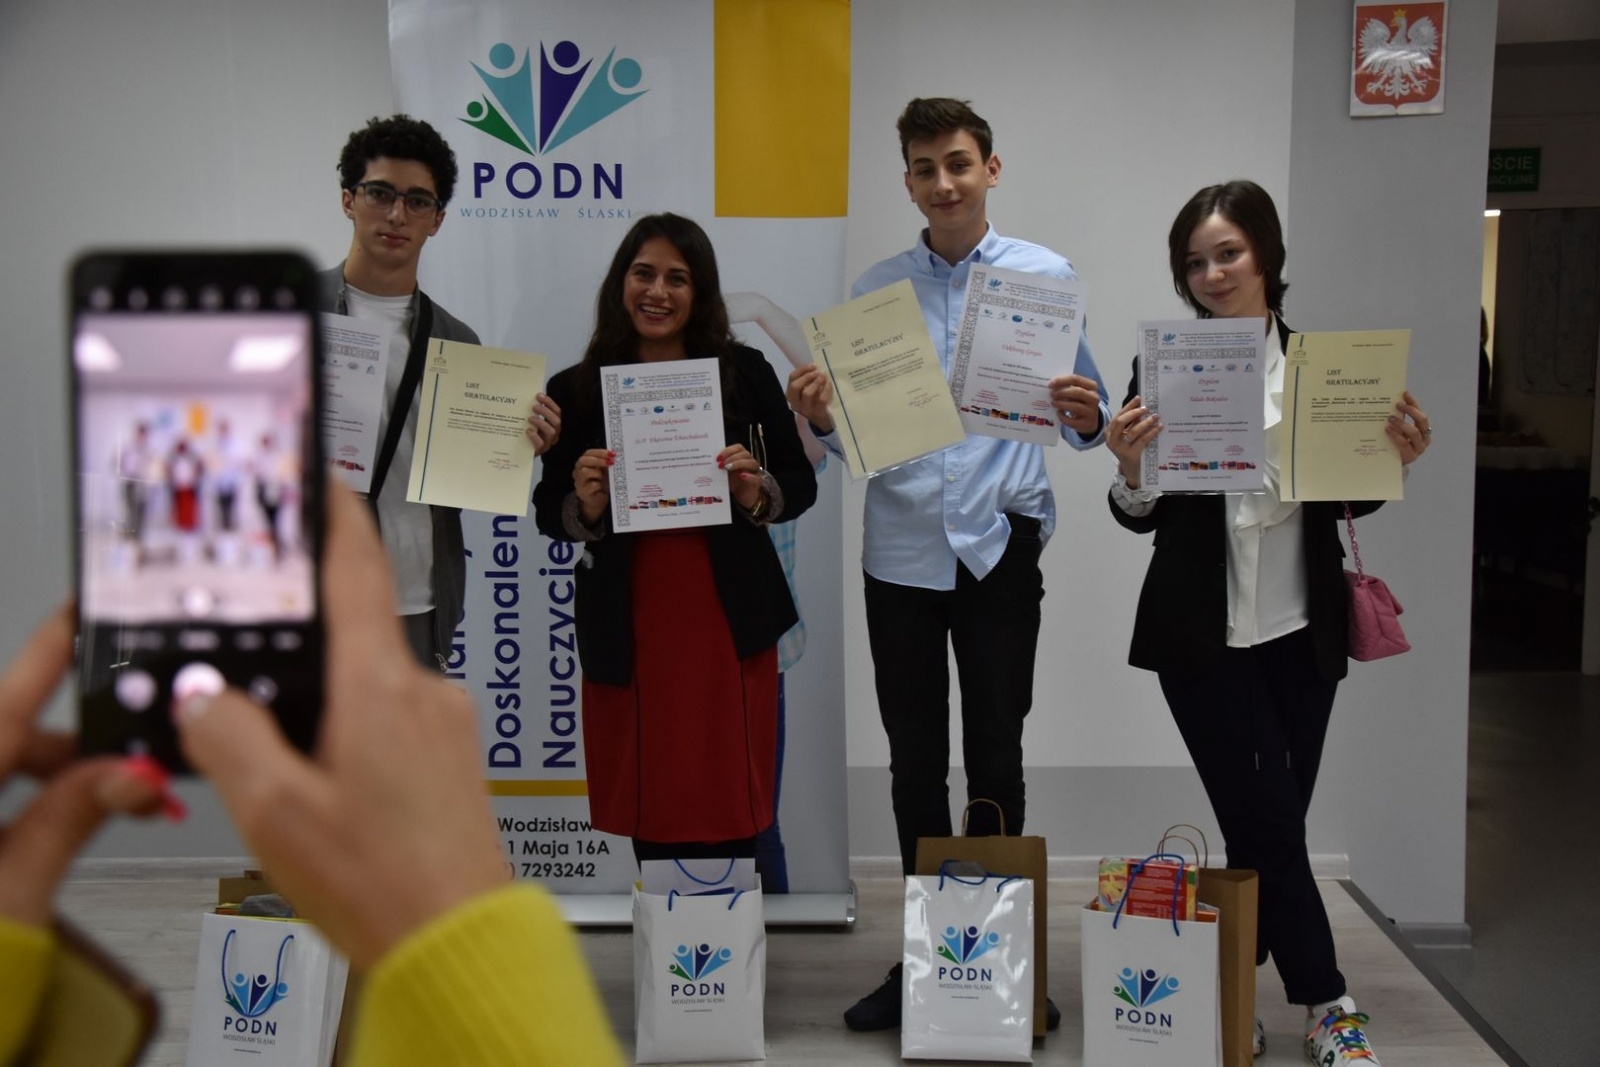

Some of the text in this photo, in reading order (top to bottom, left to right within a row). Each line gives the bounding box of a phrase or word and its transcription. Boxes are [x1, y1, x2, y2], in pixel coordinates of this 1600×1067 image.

[1491, 154, 1533, 170] ŚCIE
[473, 162, 623, 199] PODN
[1489, 173, 1536, 184] ACYJNE
[460, 208, 559, 218] WODZISŁAW
[851, 338, 865, 347] LIST
[465, 381, 481, 390] LIST
[484, 515, 522, 769] Doskonalen
[539, 530, 577, 769] Nauczycie
[497, 817, 592, 832] Wodzisław
[507, 840, 610, 858] 1 Maja 16A
[521, 862, 596, 877] 7293242
[939, 966, 992, 982] PODN
[671, 983, 725, 997] PODN
[224, 1016, 276, 1035] PODN
[1116, 1008, 1171, 1027] PODN
